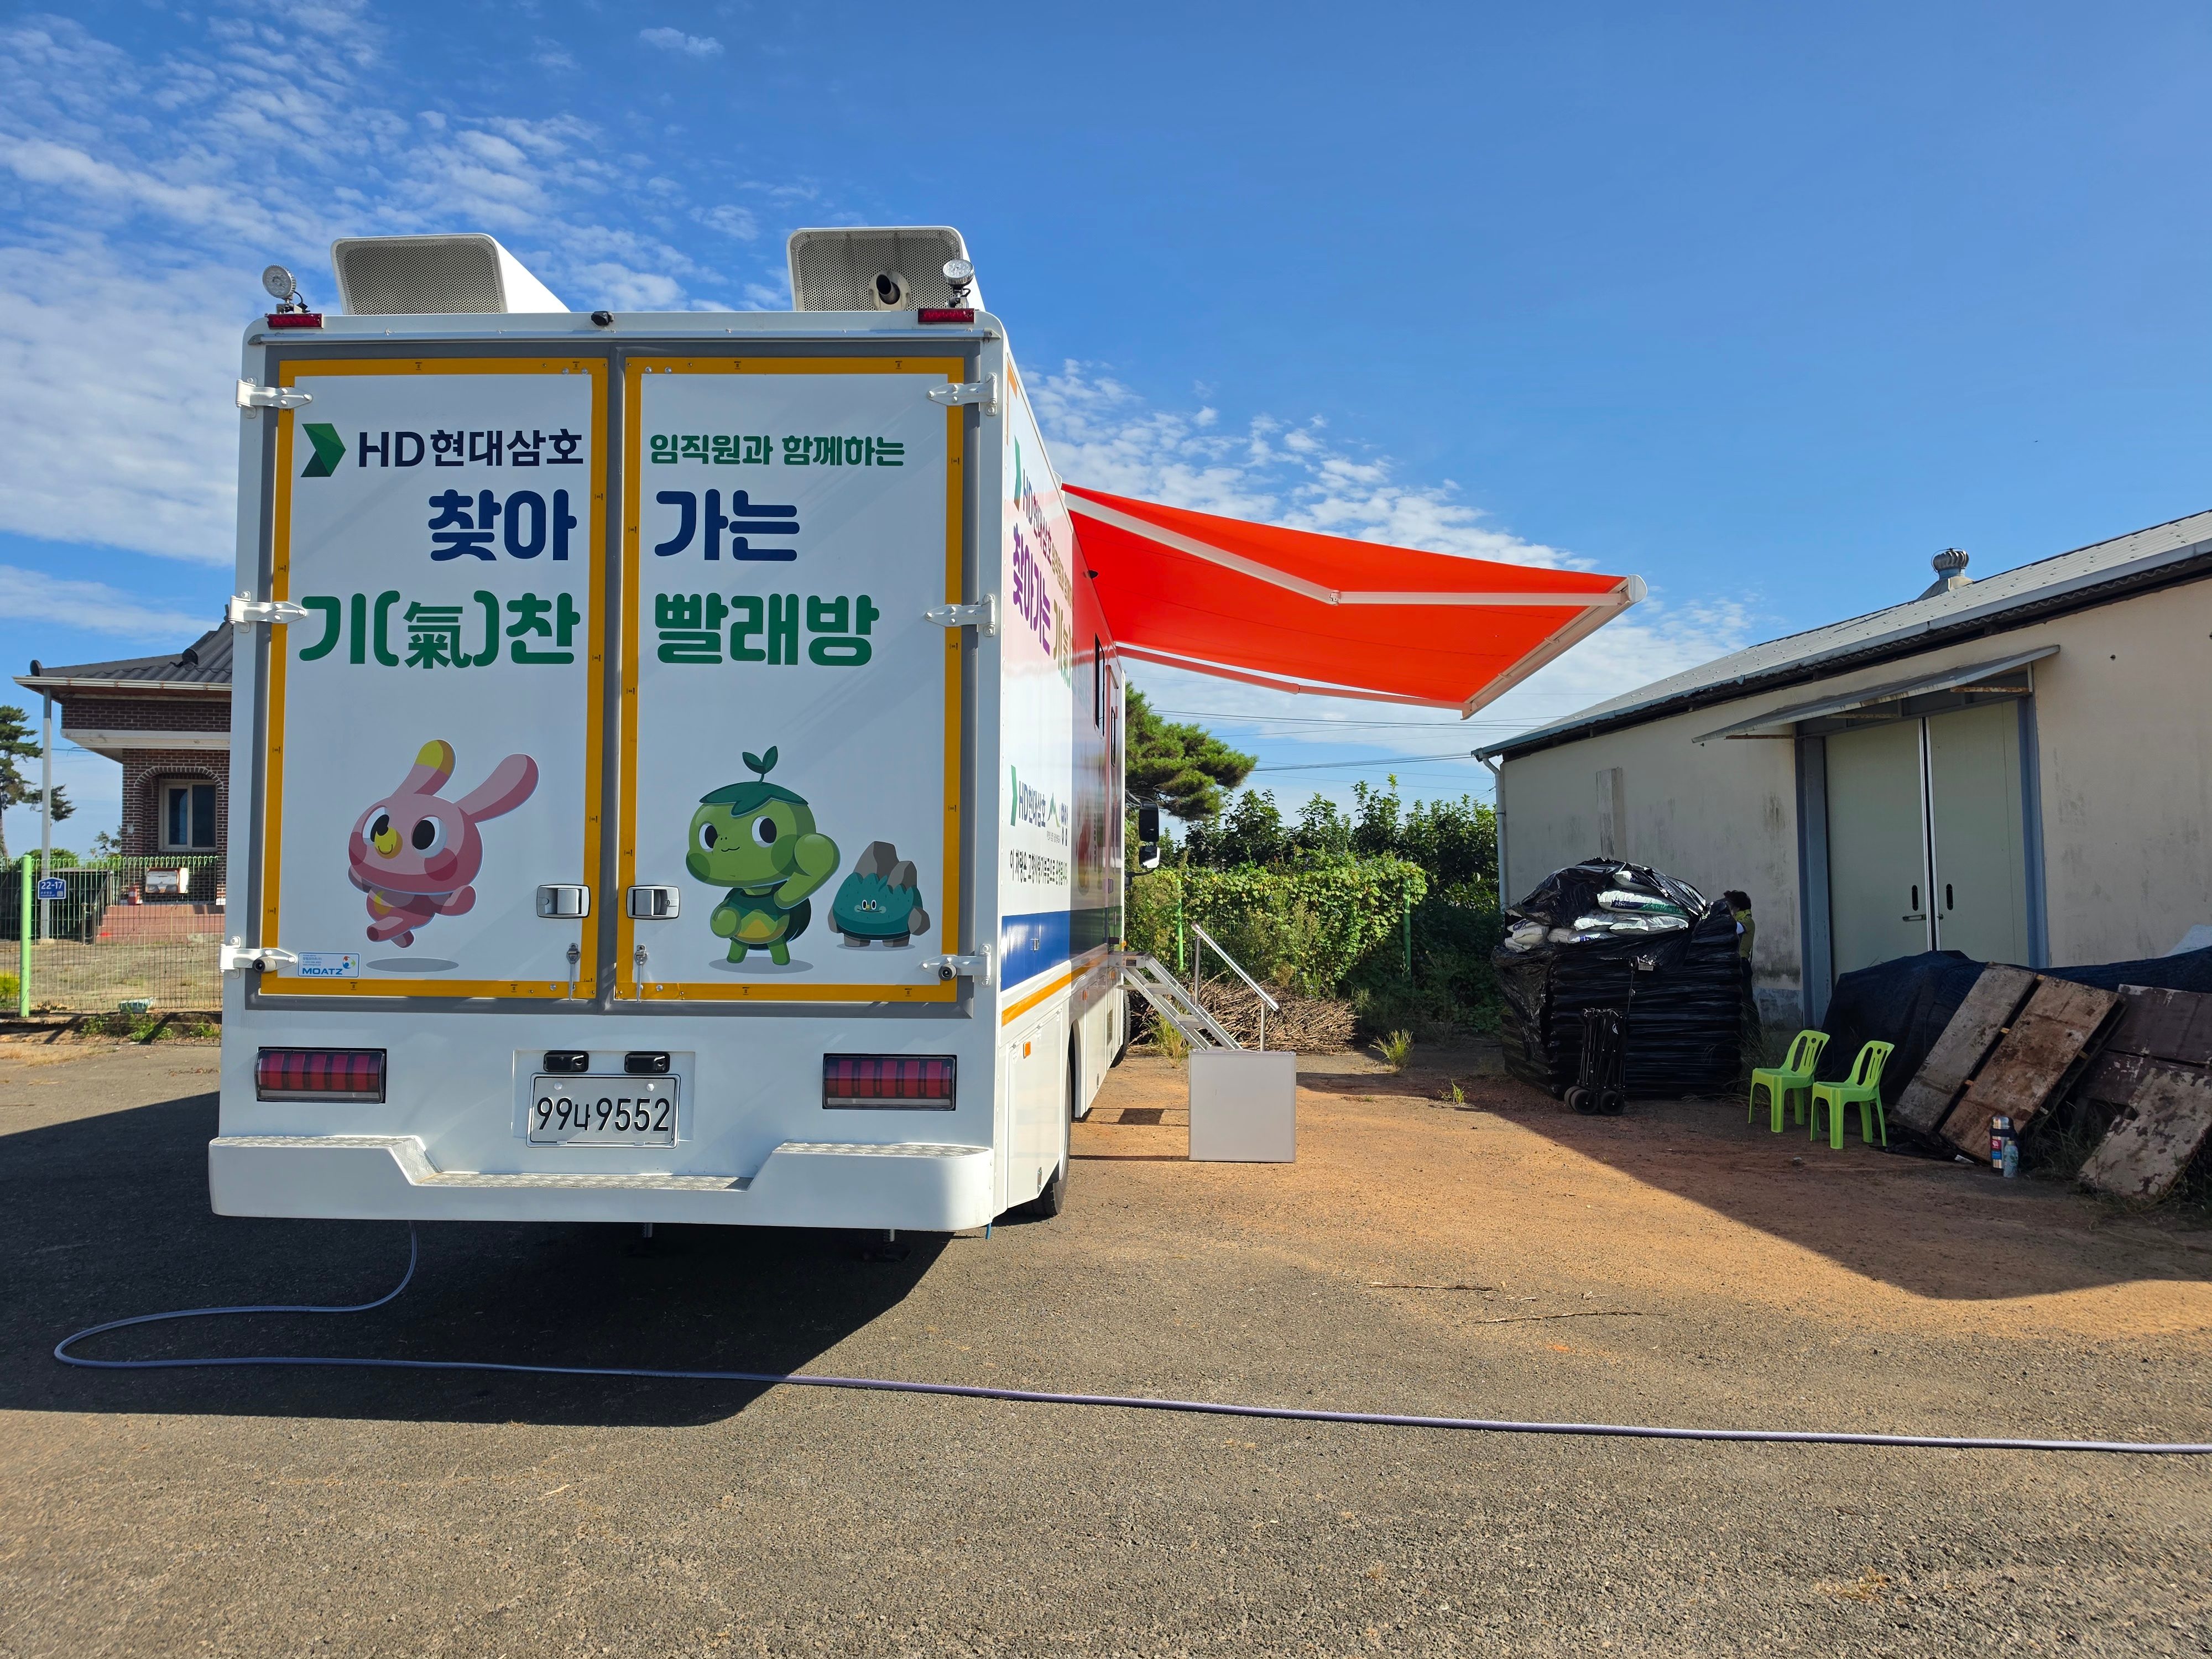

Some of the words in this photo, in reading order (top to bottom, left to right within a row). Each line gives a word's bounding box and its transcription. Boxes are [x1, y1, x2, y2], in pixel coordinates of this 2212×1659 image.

[358, 429, 583, 467] HD현대삼호
[650, 434, 773, 465] 임직원과
[782, 435, 905, 466] 함께하는
[428, 489, 577, 561] 찾아
[654, 489, 800, 561] 가는
[1023, 467, 1052, 567] HD현대삼호
[1013, 522, 1051, 656] 찾아가는
[299, 590, 581, 669] 기(氣)찬
[655, 592, 880, 666] 빨래방
[1019, 780, 1046, 827] HD현대삼호
[41, 881, 63, 890] 22-17
[1010, 848, 1014, 881] 이
[1015, 849, 1027, 883] 차량은
[536, 1097, 670, 1131] 99나9552
